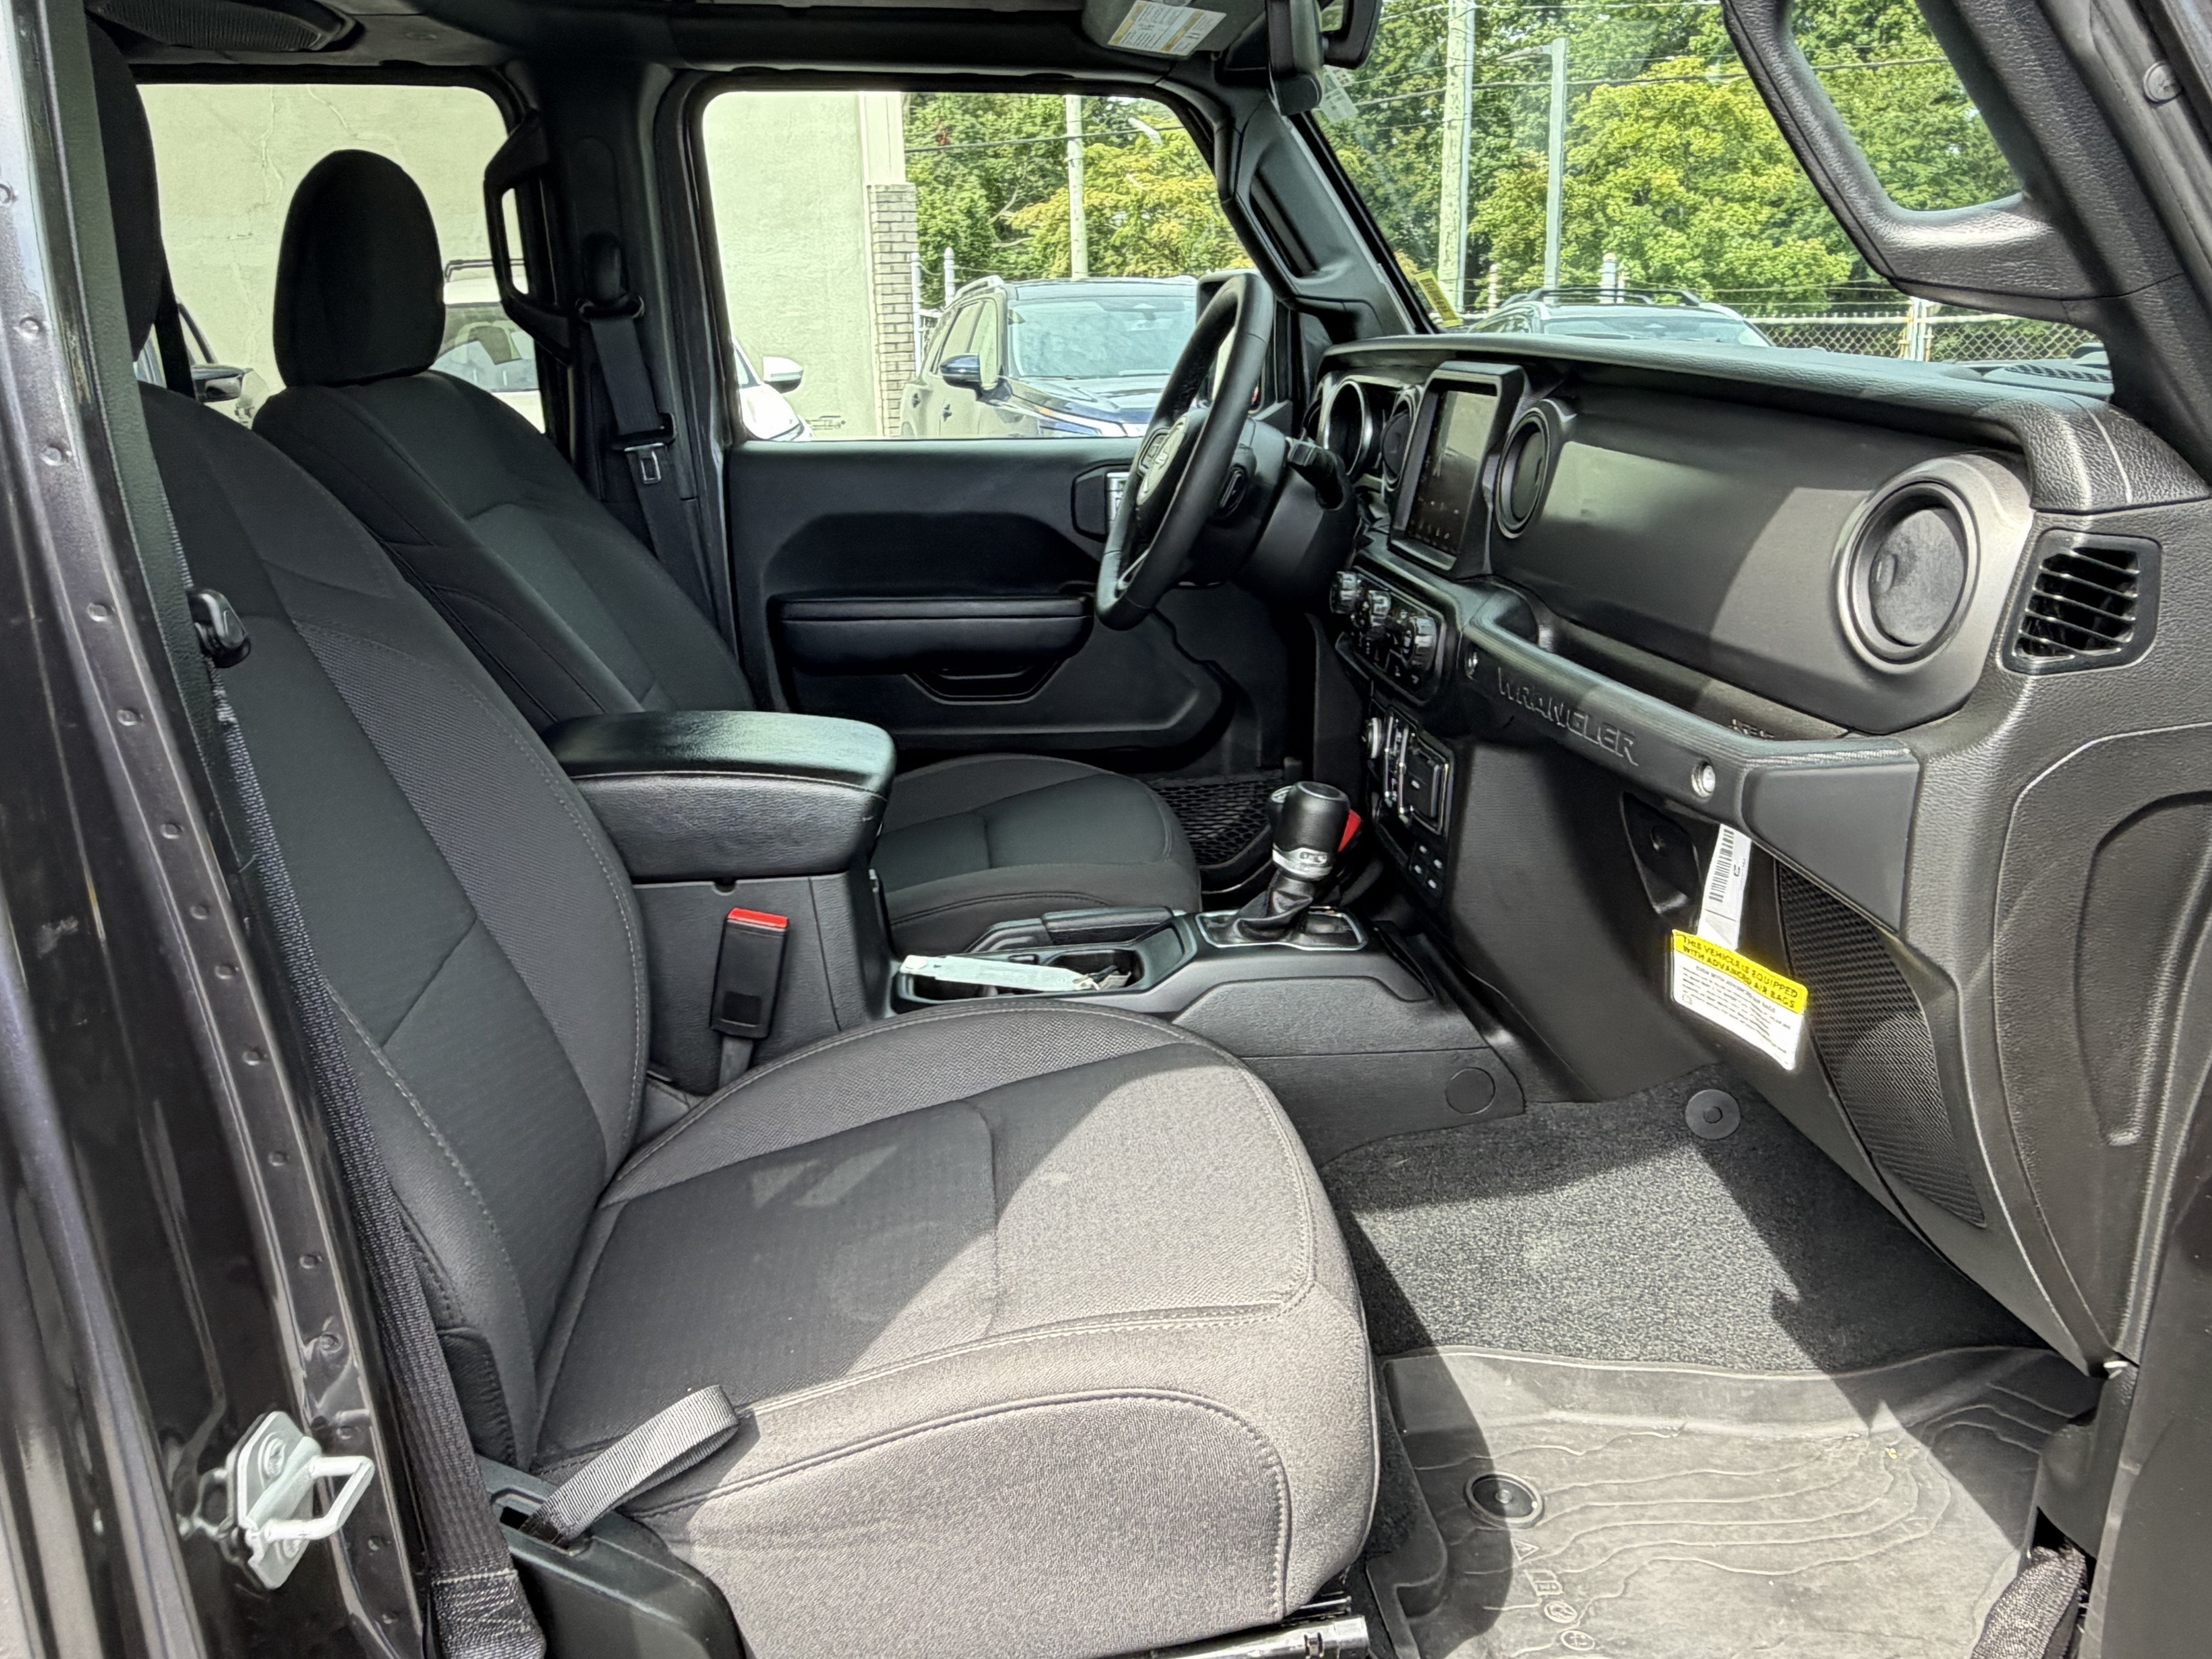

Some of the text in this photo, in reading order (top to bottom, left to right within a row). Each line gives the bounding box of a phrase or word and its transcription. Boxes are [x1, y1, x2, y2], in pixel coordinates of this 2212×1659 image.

[1498, 666, 1639, 767] WRANGLER
[1682, 935, 1702, 950] THIS
[1704, 945, 1740, 969] VEHICLE
[1741, 963, 1750, 974] IS
[1751, 969, 1798, 998] EQUIPPED
[1683, 945, 1796, 1008] WITH ADVANCED AIR BAGS
